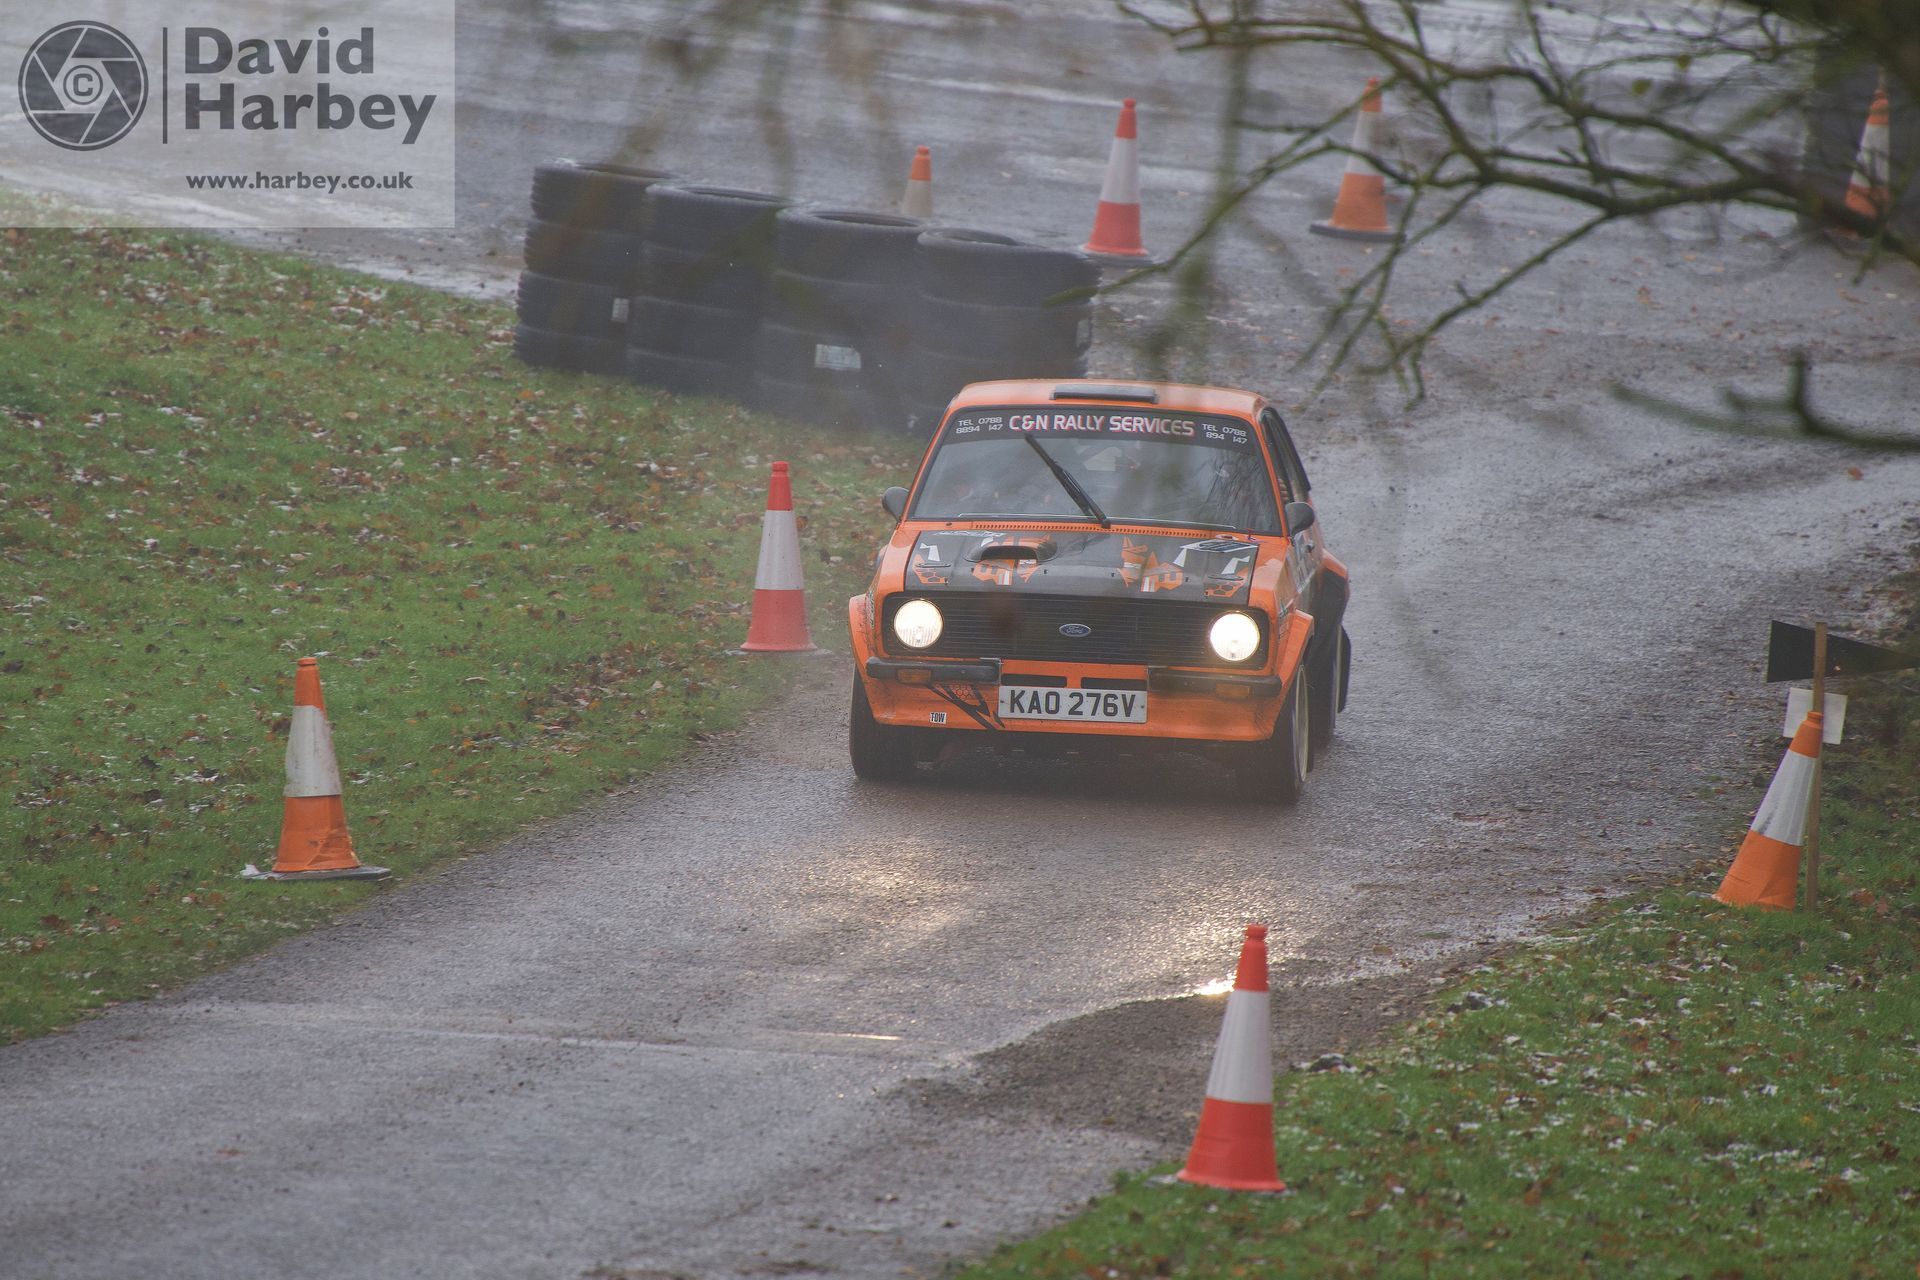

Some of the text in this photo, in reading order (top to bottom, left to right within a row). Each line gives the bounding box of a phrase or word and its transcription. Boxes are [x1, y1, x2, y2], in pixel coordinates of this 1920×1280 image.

[958, 416, 1003, 427] TEL 0788
[988, 423, 1003, 432] 147
[1009, 414, 1196, 437] C&N RALLY SERVICES
[1201, 423, 1247, 438] TEL 0788
[1206, 431, 1248, 444] 894 147
[1009, 689, 1136, 718] KAO 276V
[930, 712, 946, 723] TOW
